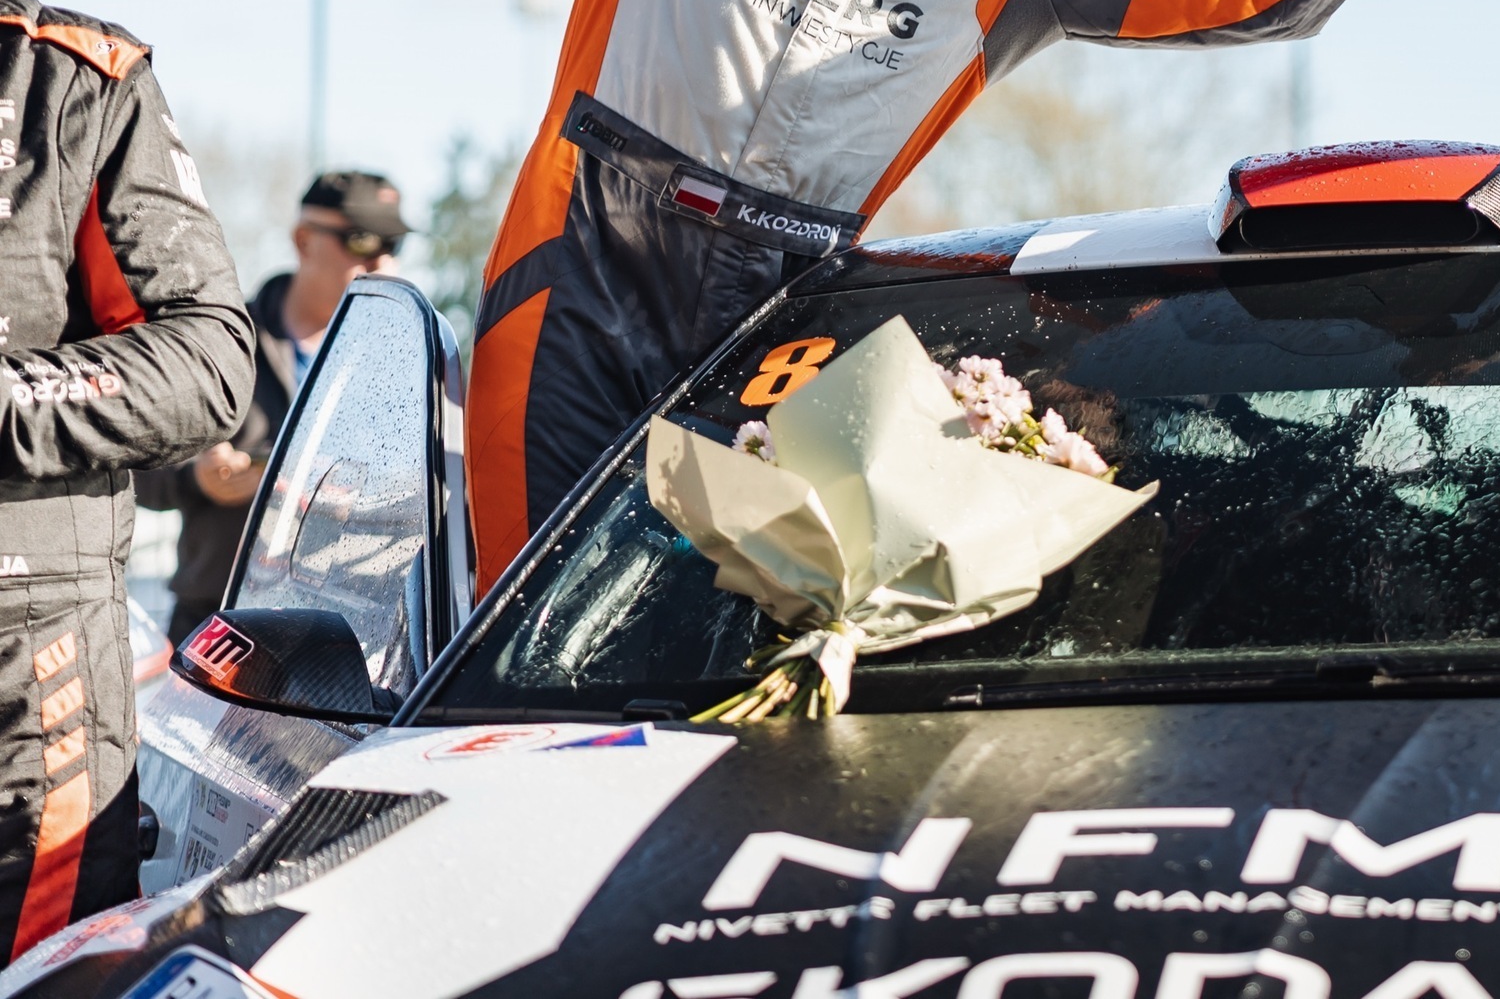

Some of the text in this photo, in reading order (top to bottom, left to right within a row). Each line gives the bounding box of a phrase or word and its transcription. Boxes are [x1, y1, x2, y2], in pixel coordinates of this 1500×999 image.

[740, 336, 837, 408] 8
[653, 895, 895, 945] NIVETTE
[913, 889, 1098, 922] FLEET
